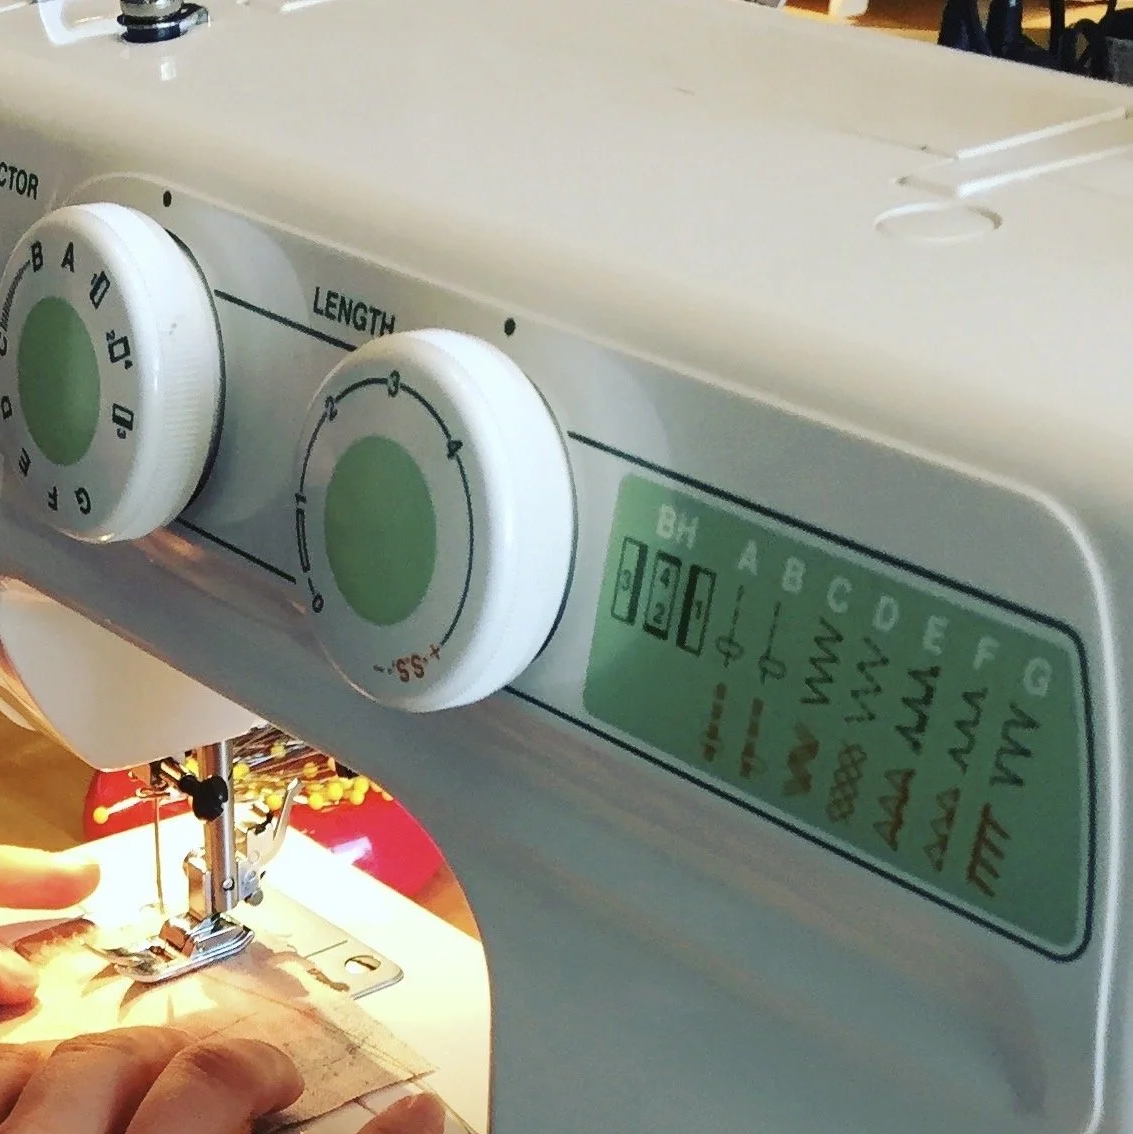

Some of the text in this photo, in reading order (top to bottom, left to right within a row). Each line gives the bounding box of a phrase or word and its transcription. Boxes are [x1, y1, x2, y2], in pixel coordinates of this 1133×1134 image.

[30, 240, 44, 273] B
[61, 241, 75, 273] A
[313, 286, 396, 337] LENGTH
[387, 370, 401, 398] 3
[325, 396, 338, 421] 2
[18, 447, 32, 478] E
[446, 440, 463, 460] 4
[73, 487, 92, 515] G
[312, 592, 325, 614] 0
[656, 503, 1054, 697] BH A B C D E F G
